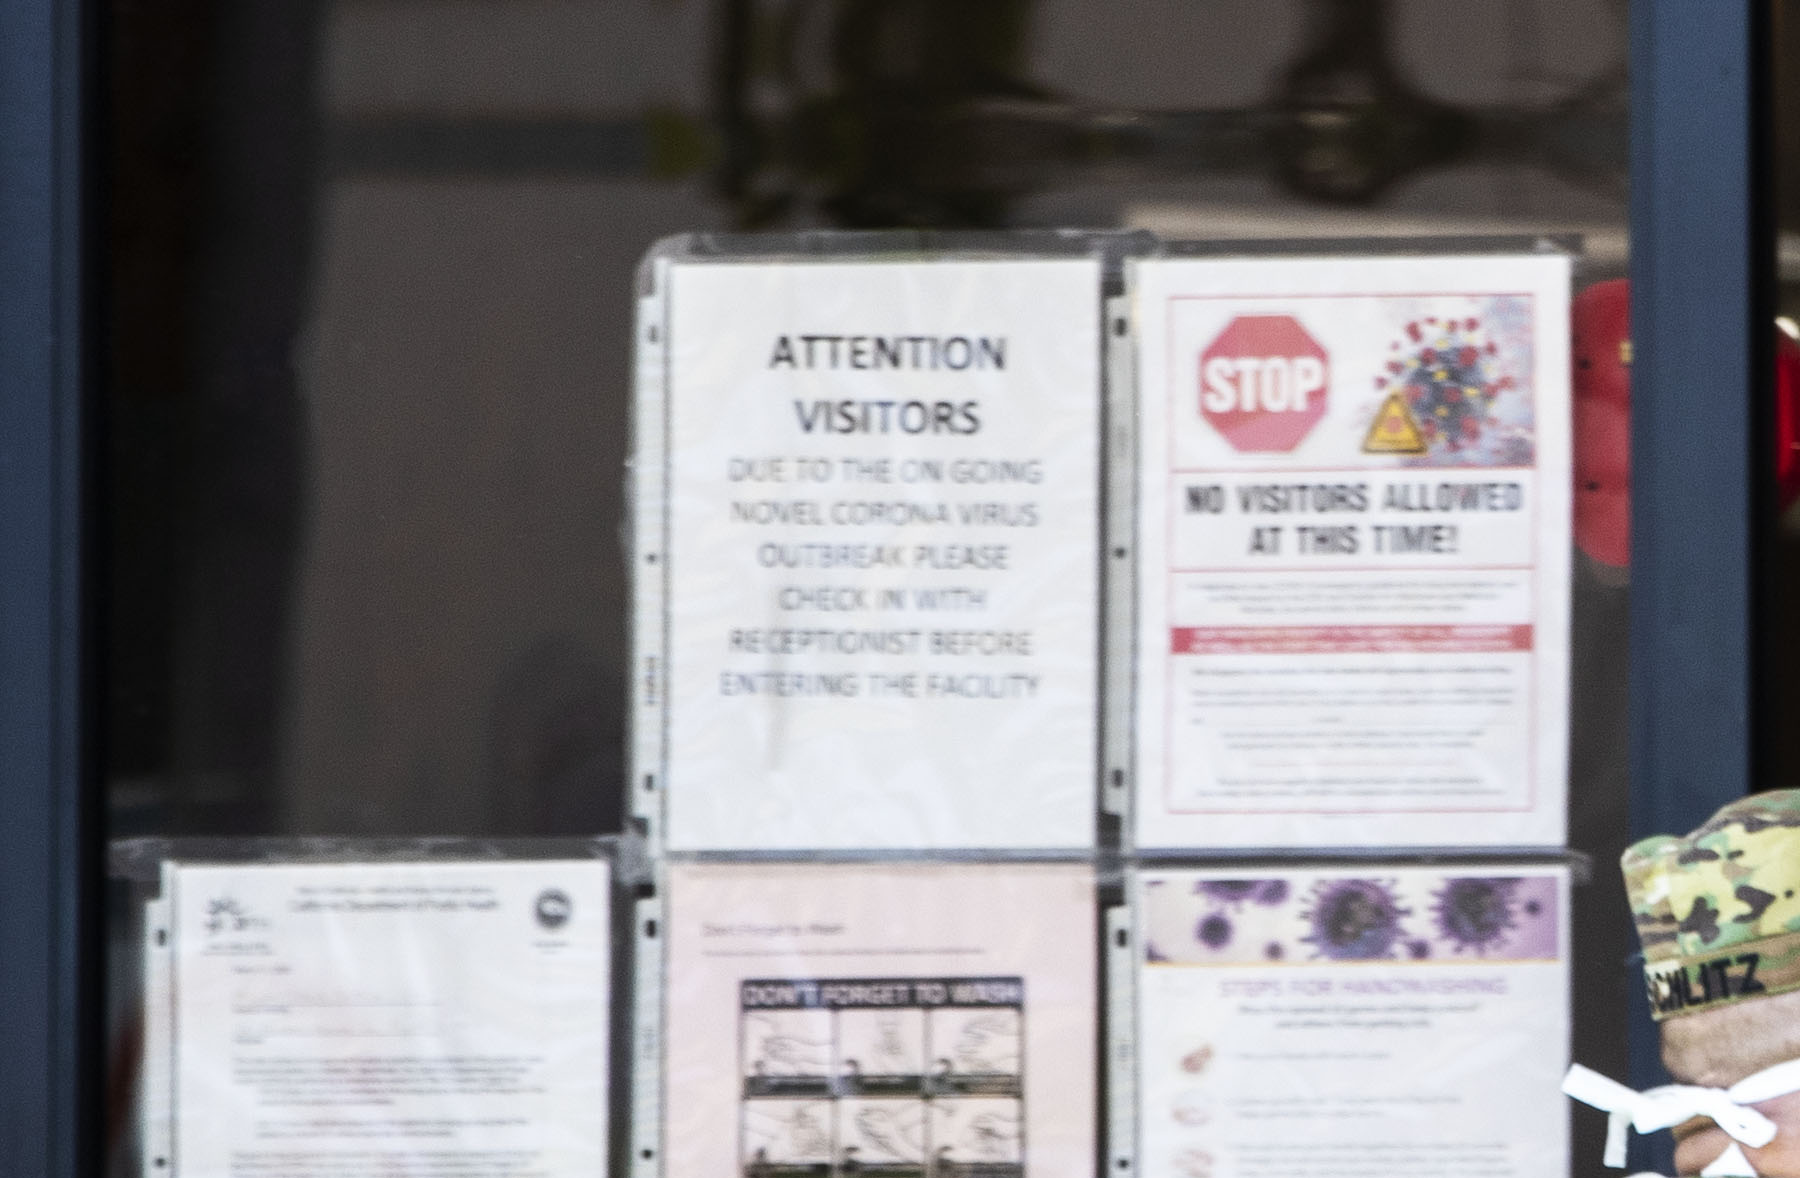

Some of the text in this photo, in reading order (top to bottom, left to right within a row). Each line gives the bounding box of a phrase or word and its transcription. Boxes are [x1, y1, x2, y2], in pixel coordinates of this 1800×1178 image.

[769, 336, 1007, 370] ATTENTION
[1204, 357, 1323, 413] STOP
[795, 401, 981, 434] VISITORS
[728, 459, 1043, 484] DUE TO THE ON GOING
[1184, 483, 1524, 514] NO VISITORS ALLOWED
[729, 501, 1040, 527] NOVEL CORONA VIRUS
[1247, 526, 1282, 555] AT
[1296, 525, 1359, 554] THIS
[757, 543, 1009, 569] OUTBREAK PLEASE
[780, 587, 986, 612] CHECK IN WITH
[728, 629, 1034, 655] RECEPTIONIST BEFORE
[719, 672, 1041, 698] ENTERING THE FACILITY
